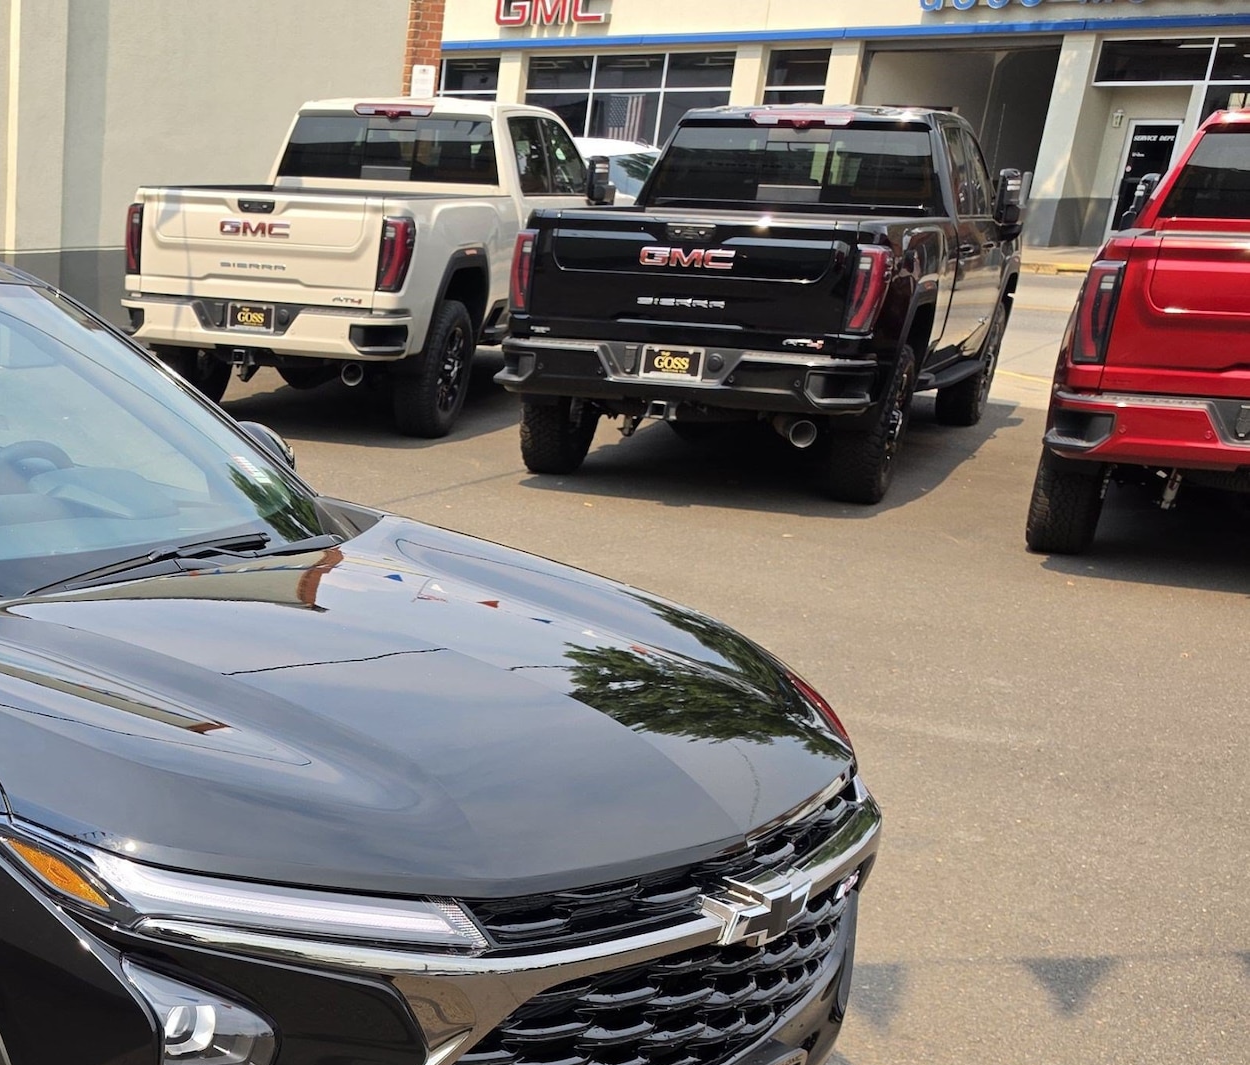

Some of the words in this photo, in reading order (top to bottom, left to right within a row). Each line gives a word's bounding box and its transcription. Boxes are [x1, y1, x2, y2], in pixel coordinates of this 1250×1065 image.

[495, 0, 604, 26] GMC
[220, 220, 291, 238] GMC
[639, 246, 736, 269] GMC
[637, 297, 725, 308] SIERRA
[237, 311, 265, 324] GOSS
[653, 355, 690, 370] GOSS
